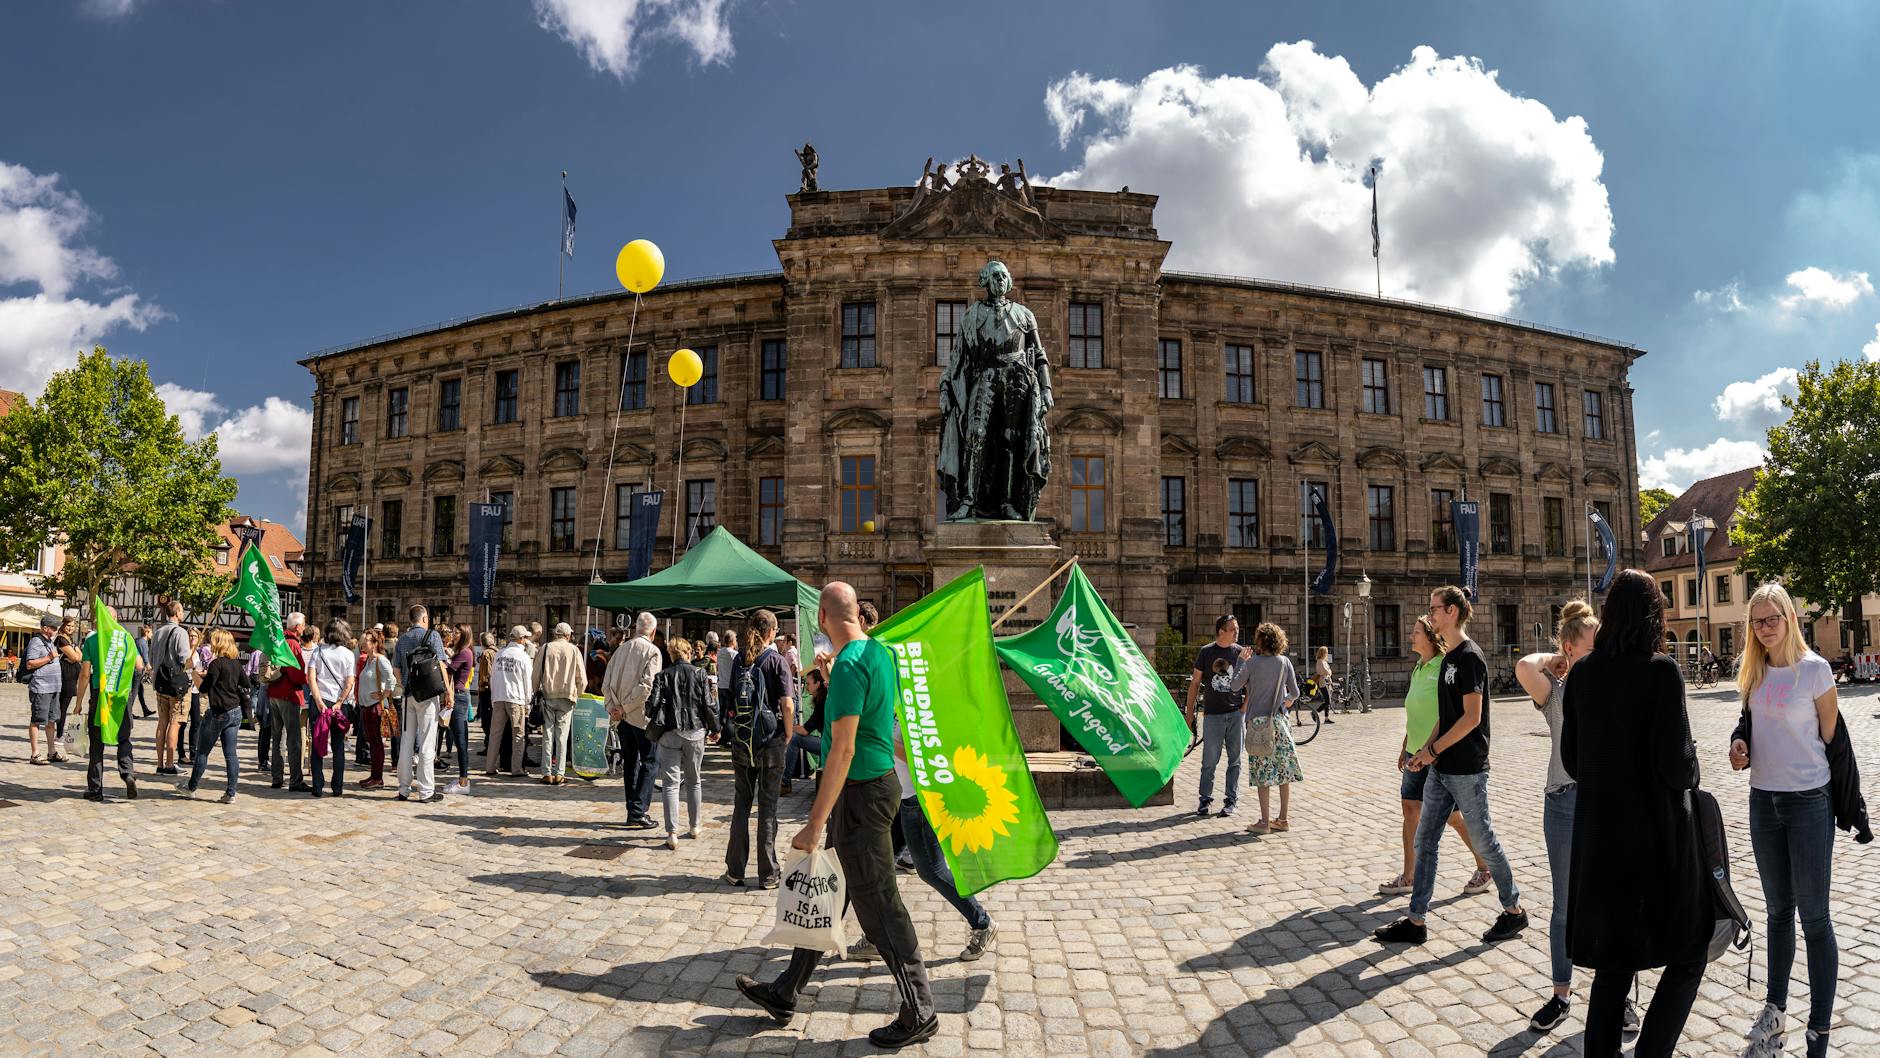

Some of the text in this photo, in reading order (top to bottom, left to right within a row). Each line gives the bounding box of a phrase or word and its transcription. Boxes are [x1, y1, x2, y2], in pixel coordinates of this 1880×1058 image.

[643, 494, 660, 506] FAU
[1461, 504, 1476, 514] FAU
[481, 506, 501, 516] FAU
[245, 595, 267, 620] Grüne
[893, 643, 931, 787] DIE GRÜNEN
[906, 641, 955, 784] BÜNDNIS 90
[1033, 663, 1130, 755] Grüne Jugend
[797, 901, 819, 915] IS A
[783, 911, 832, 929] KILLER
